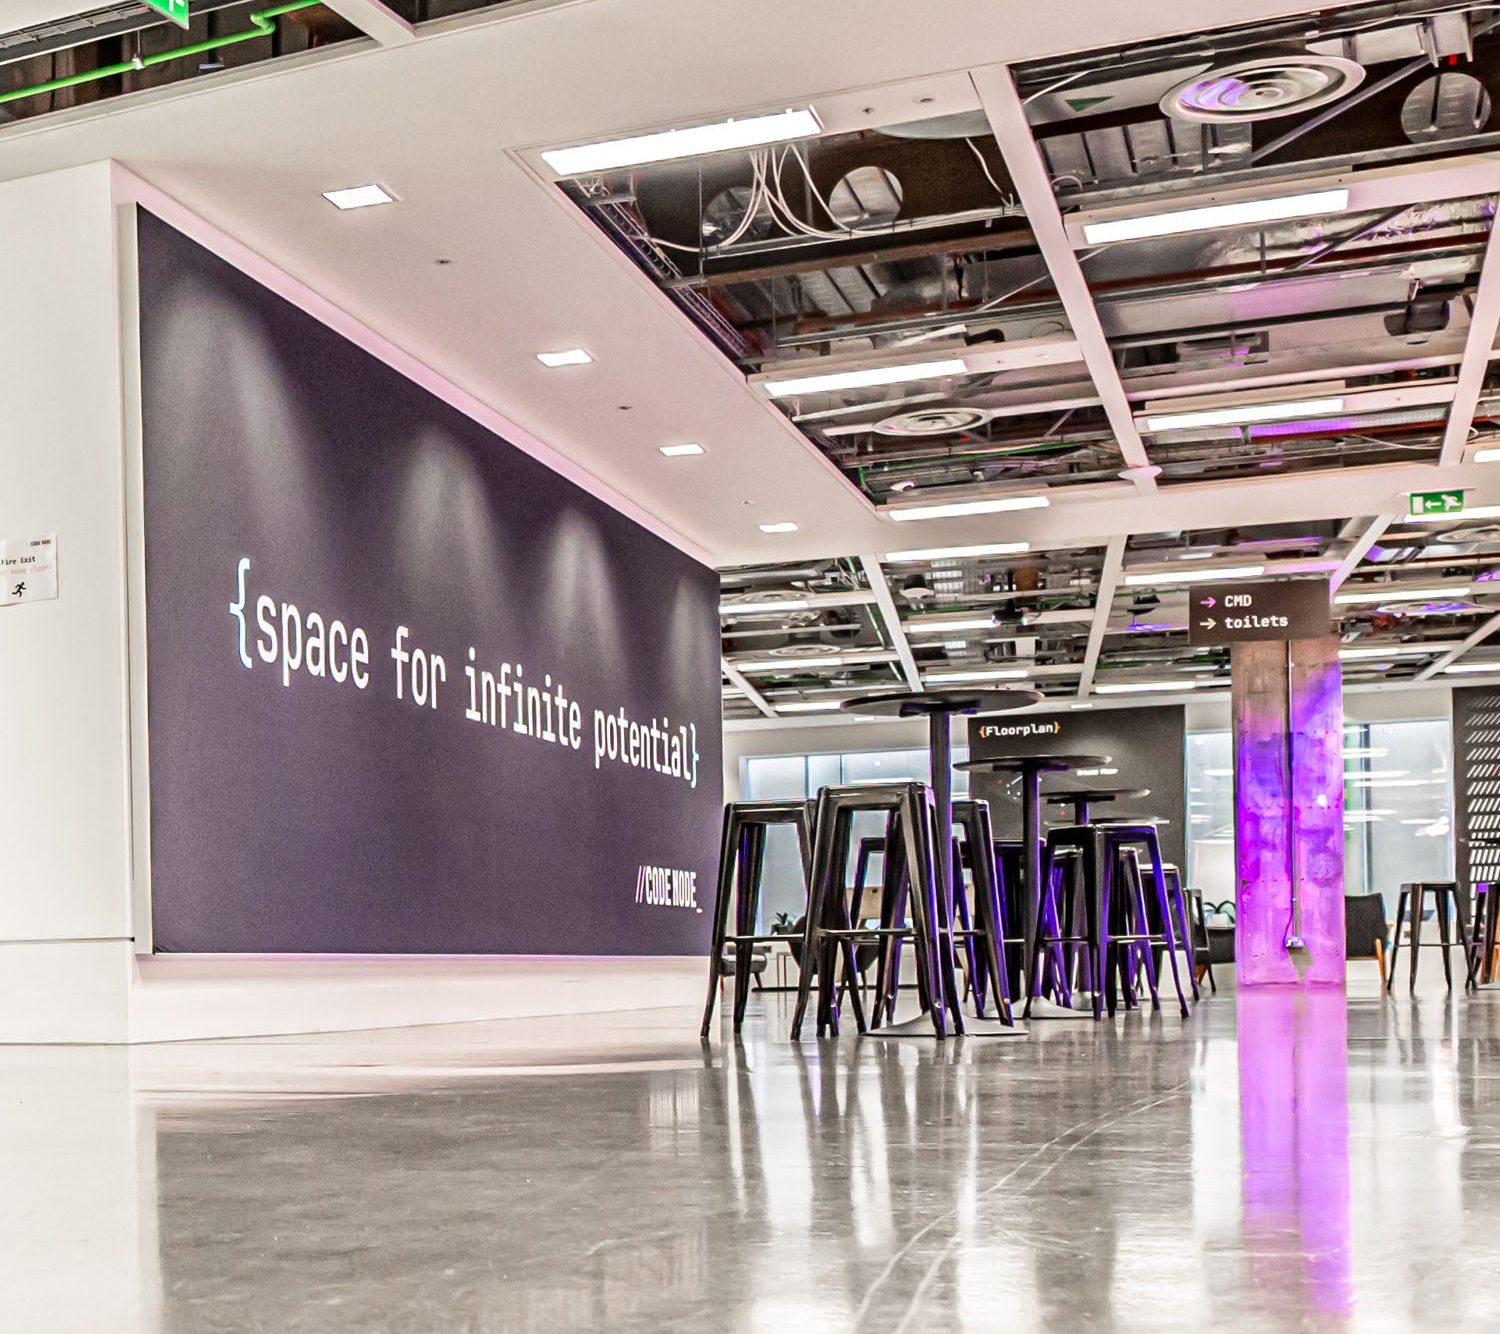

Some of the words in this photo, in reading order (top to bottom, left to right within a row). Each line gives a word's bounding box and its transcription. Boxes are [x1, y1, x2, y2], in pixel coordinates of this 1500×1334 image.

[20, 556, 36, 564] Exit
[1224, 594, 1253, 607] CMD
[1224, 615, 1289, 629] toilets
[390, 625, 446, 709] for
[465, 646, 582, 750] infinite
